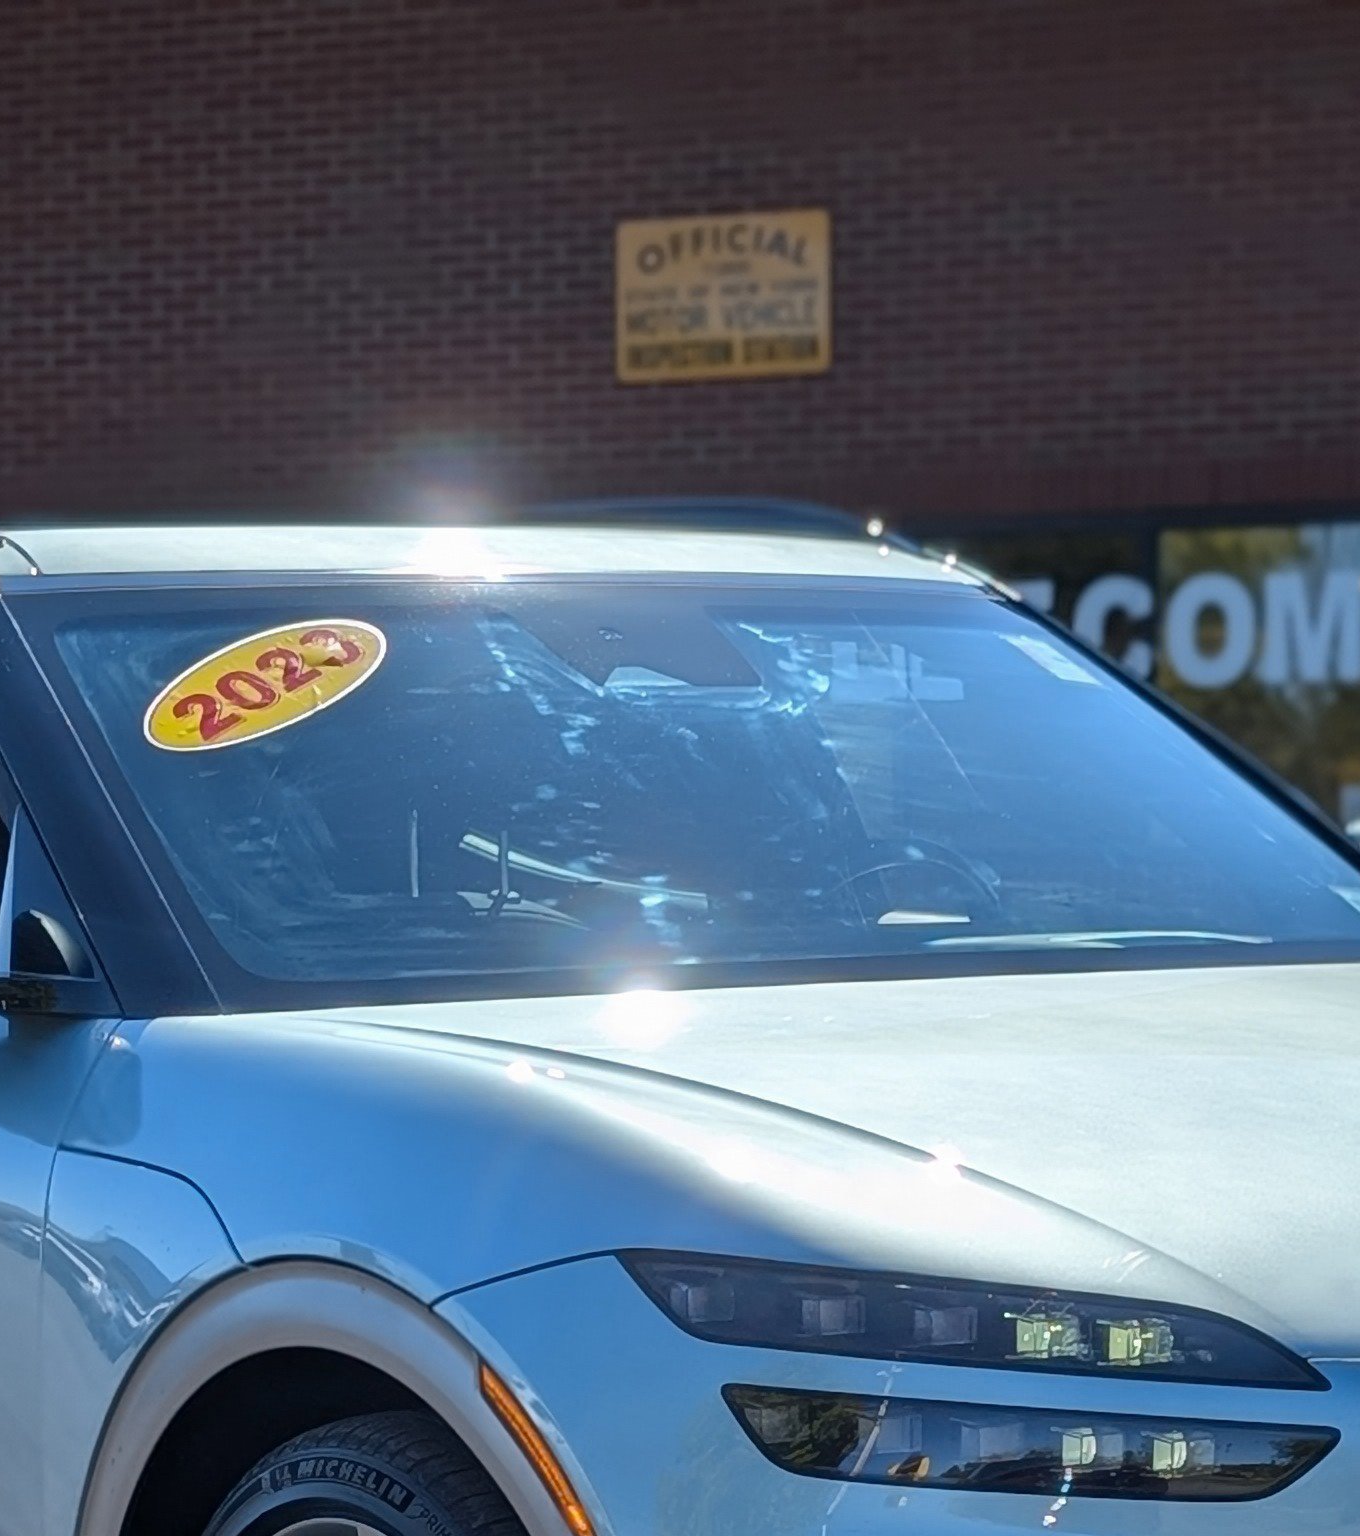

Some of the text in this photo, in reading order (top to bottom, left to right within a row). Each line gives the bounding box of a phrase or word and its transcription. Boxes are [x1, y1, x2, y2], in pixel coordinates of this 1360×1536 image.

[636, 223, 807, 276] OFFICIAL
[625, 296, 818, 336] MOTOR VEHICLE
[626, 333, 820, 370] INSPECTION STATION
[172, 628, 367, 742] 2023
[296, 1457, 408, 1510] MICHELIN
